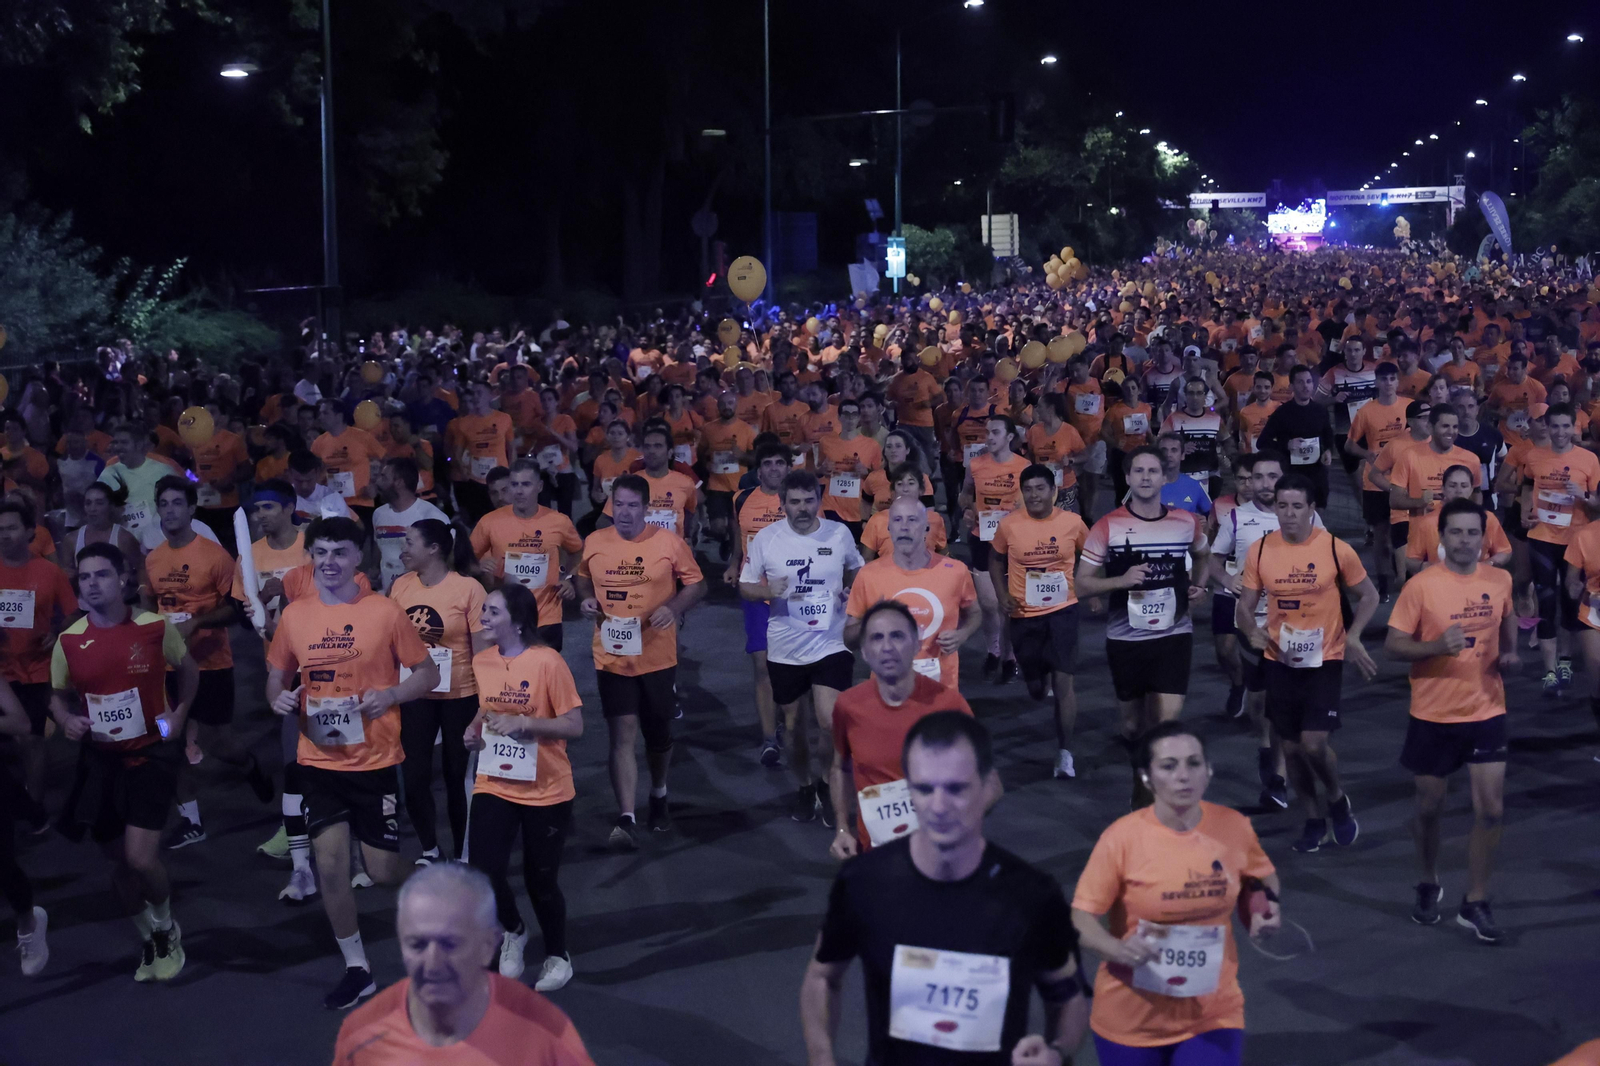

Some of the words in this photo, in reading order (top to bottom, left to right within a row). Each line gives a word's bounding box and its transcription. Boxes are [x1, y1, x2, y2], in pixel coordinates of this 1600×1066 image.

[515, 565, 540, 574] 10049
[1036, 584, 1060, 592] 12861
[799, 604, 827, 616] 16692
[1142, 603, 1165, 614] 8227
[1450, 611, 1478, 620] SEVILLA
[607, 628, 632, 640] 10250
[1287, 641, 1315, 652] 11892
[98, 708, 132, 722] 15563
[316, 714, 350, 725] 12374
[493, 743, 526, 759] 12373
[1162, 890, 1204, 900] SEVILLA
[926, 983, 979, 1011] 7175
